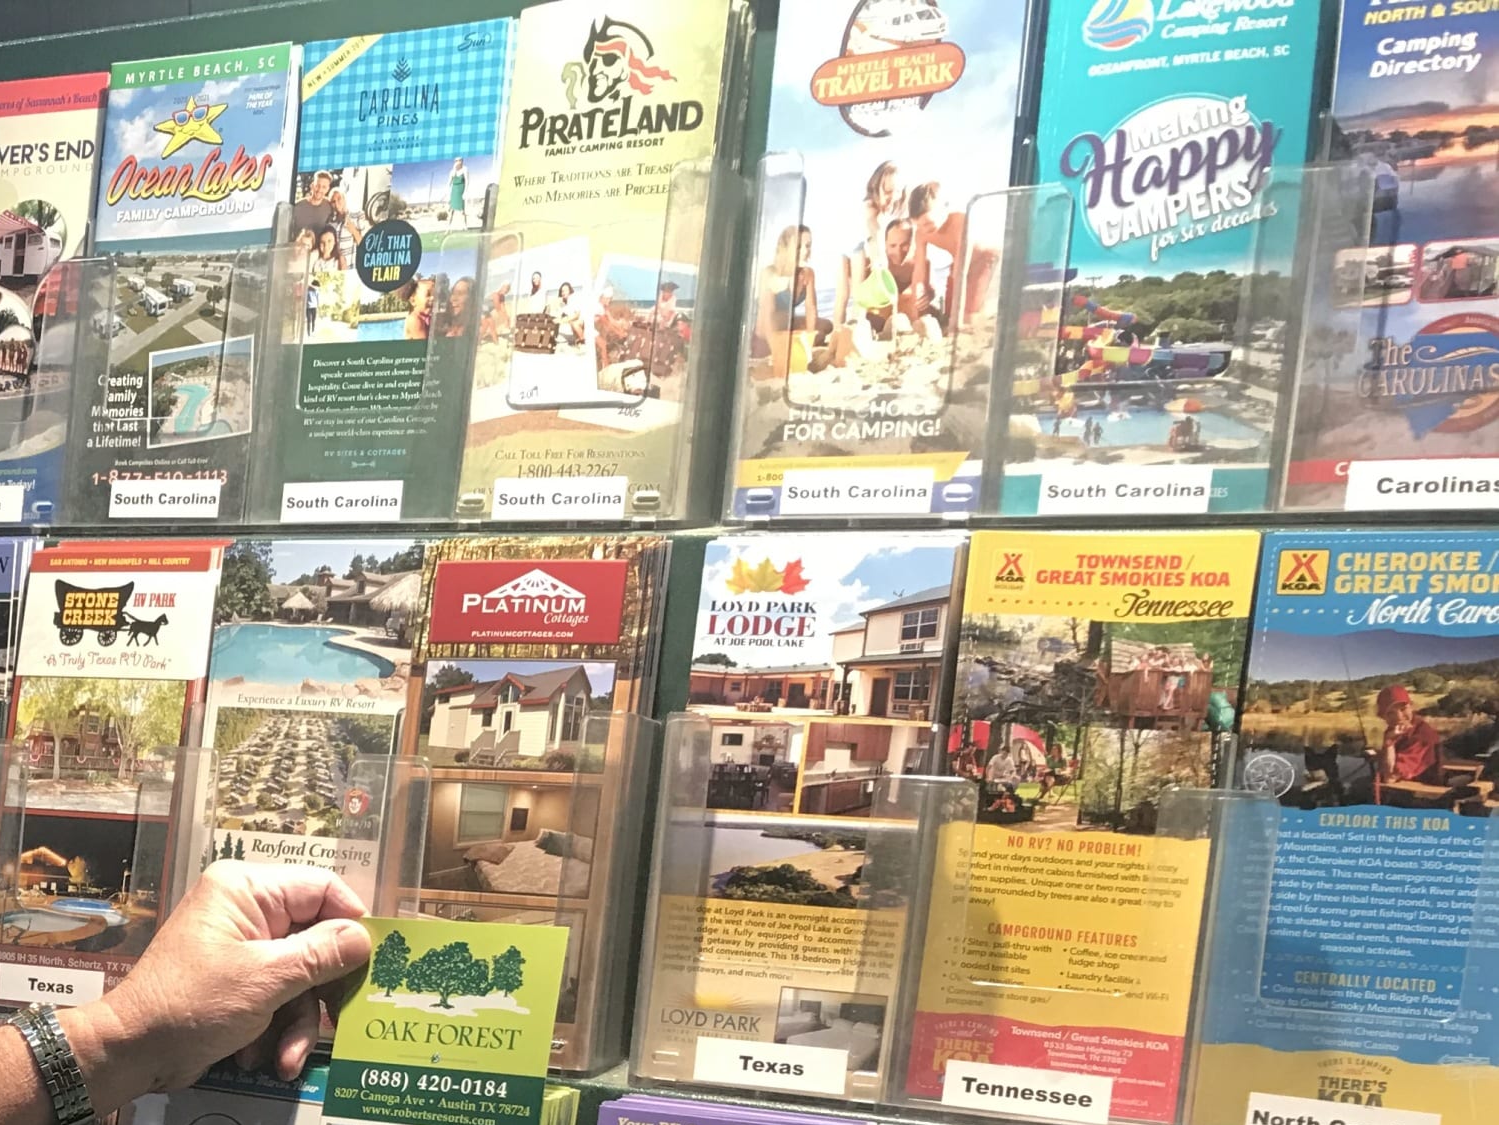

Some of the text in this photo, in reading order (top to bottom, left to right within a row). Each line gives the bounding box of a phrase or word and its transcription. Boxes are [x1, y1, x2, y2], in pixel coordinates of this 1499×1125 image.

[1364, 6, 1426, 25] NORTH
[1377, 32, 1478, 55] Camping
[837, 52, 936, 76] MYRTLE BEACH
[1173, 52, 1221, 66] MYRTLE
[1273, 44, 1290, 56] SC
[125, 56, 276, 84] MYRTLE BEACH, SC
[1369, 53, 1482, 78] Directory
[816, 62, 954, 98] TRAVEL PARK
[359, 83, 439, 122] CAROLINA
[377, 115, 418, 127] PINES
[55, 140, 94, 161] END
[545, 138, 664, 157] FAMILY CAMPING RESORT
[107, 145, 272, 205] Ocean Lakes
[1059, 122, 1282, 210] Happy
[117, 200, 254, 222] FAMILY CAMPGROUND
[1101, 174, 1251, 247] CAMPERS
[388, 235, 412, 249] THAT
[364, 252, 411, 267] CAROLINA
[372, 267, 400, 281] FLAIR
[783, 419, 941, 441] FOR CAMPING!
[114, 492, 217, 505] South Carolina
[498, 492, 622, 505] South Carolina
[788, 485, 927, 499] South Carolina
[1047, 483, 1205, 499] South Carolina
[287, 495, 398, 508] South Carolina
[1076, 554, 1182, 569] TOWNSEND
[1337, 552, 1481, 571] CHEROKEE
[1036, 570, 1230, 586] GREAT SMOKIES KOA
[1334, 574, 1422, 594] GREAT
[65, 592, 119, 608] STONE
[133, 593, 177, 607] RV PARK
[462, 594, 586, 613] PLATINUM
[710, 600, 817, 614] LOYD PARK
[1114, 589, 1234, 618] Tennessee
[62, 609, 117, 625] CREEK
[544, 612, 589, 626] Cottages
[1346, 595, 1432, 625] North
[708, 614, 816, 637] LODGE
[728, 638, 745, 646] JOE
[748, 638, 775, 647] POOL
[778, 639, 805, 647] LAKE
[238, 694, 285, 705] Experience
[295, 695, 327, 708] Luxury
[330, 698, 342, 707] RV
[346, 699, 375, 709] Resort
[1319, 813, 1450, 831] EXPLORE THIS KOA
[252, 839, 306, 858] Rayford
[1007, 836, 1141, 856] NO RV? NO PROBLEM!
[28, 978, 74, 994] Texas
[661, 1008, 761, 1032] LOYD PARK
[365, 1019, 522, 1050] OAK FOREST
[739, 1055, 804, 1076] Texas
[360, 1068, 507, 1098] (888) 420-0184
[962, 1077, 1093, 1108] Tennessee
[334, 1087, 530, 1116] 8207 Canoga Ave Austin TX 78724
